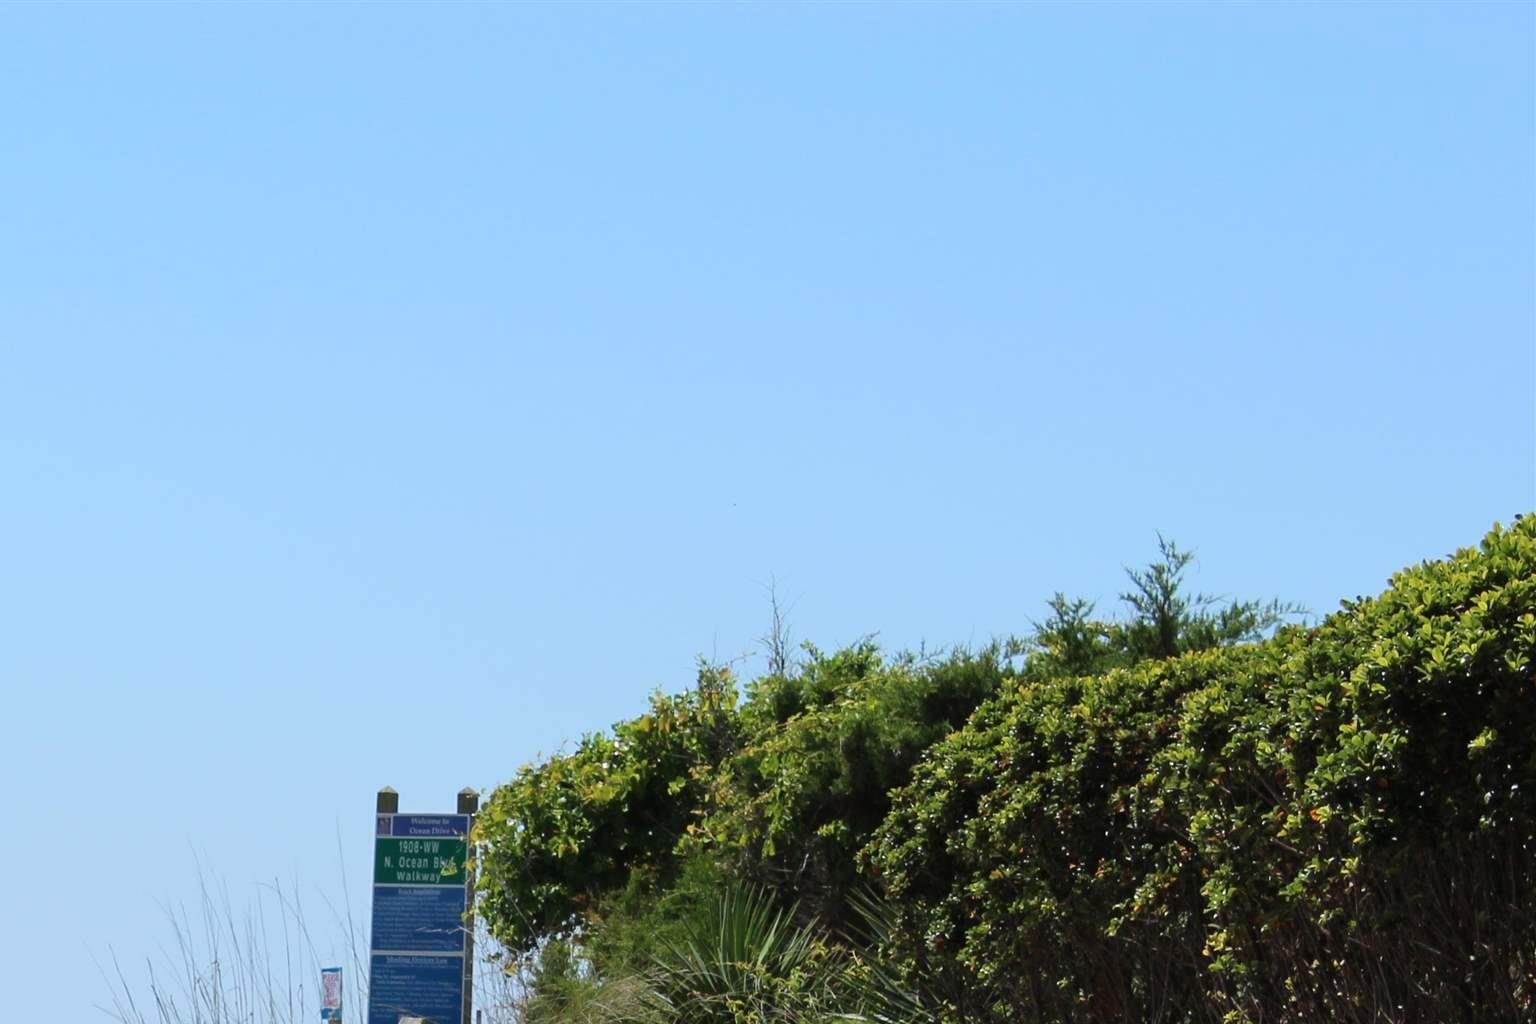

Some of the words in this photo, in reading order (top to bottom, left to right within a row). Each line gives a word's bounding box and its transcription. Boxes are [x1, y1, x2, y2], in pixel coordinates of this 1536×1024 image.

[409, 827, 430, 835] Ocean
[399, 840, 440, 853] 1908-WW
[384, 856, 394, 868] N.
[398, 856, 429, 868] Ocean
[396, 871, 441, 884] Walkway
